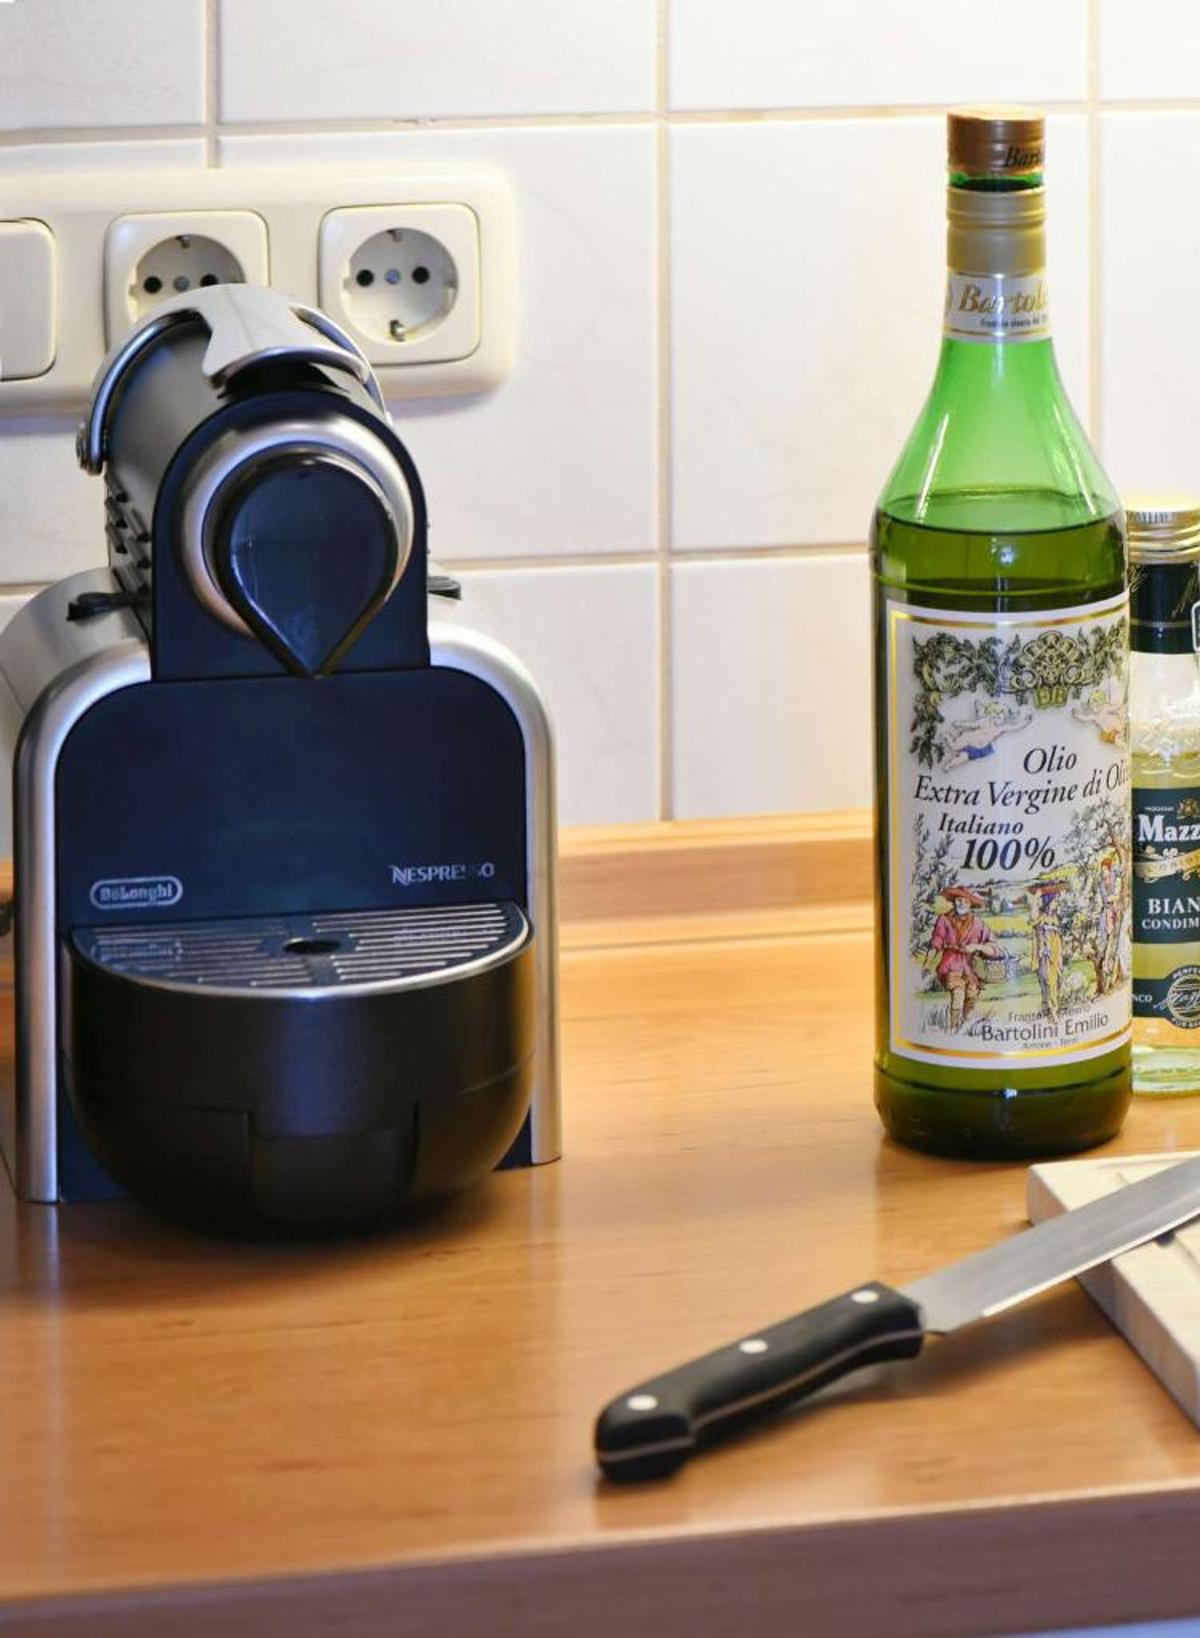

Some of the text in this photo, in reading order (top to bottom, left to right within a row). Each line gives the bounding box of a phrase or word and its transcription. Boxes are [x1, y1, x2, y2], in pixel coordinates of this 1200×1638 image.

[1023, 745, 1078, 775] Olio
[913, 775, 980, 806] Extra
[987, 778, 1077, 815] Vergine
[1082, 768, 1102, 798] di
[938, 812, 1024, 835] Italiano
[959, 835, 1056, 871] 100%
[389, 861, 495, 886] NESPREO
[982, 1013, 1109, 1042] Bartolini Emilio
